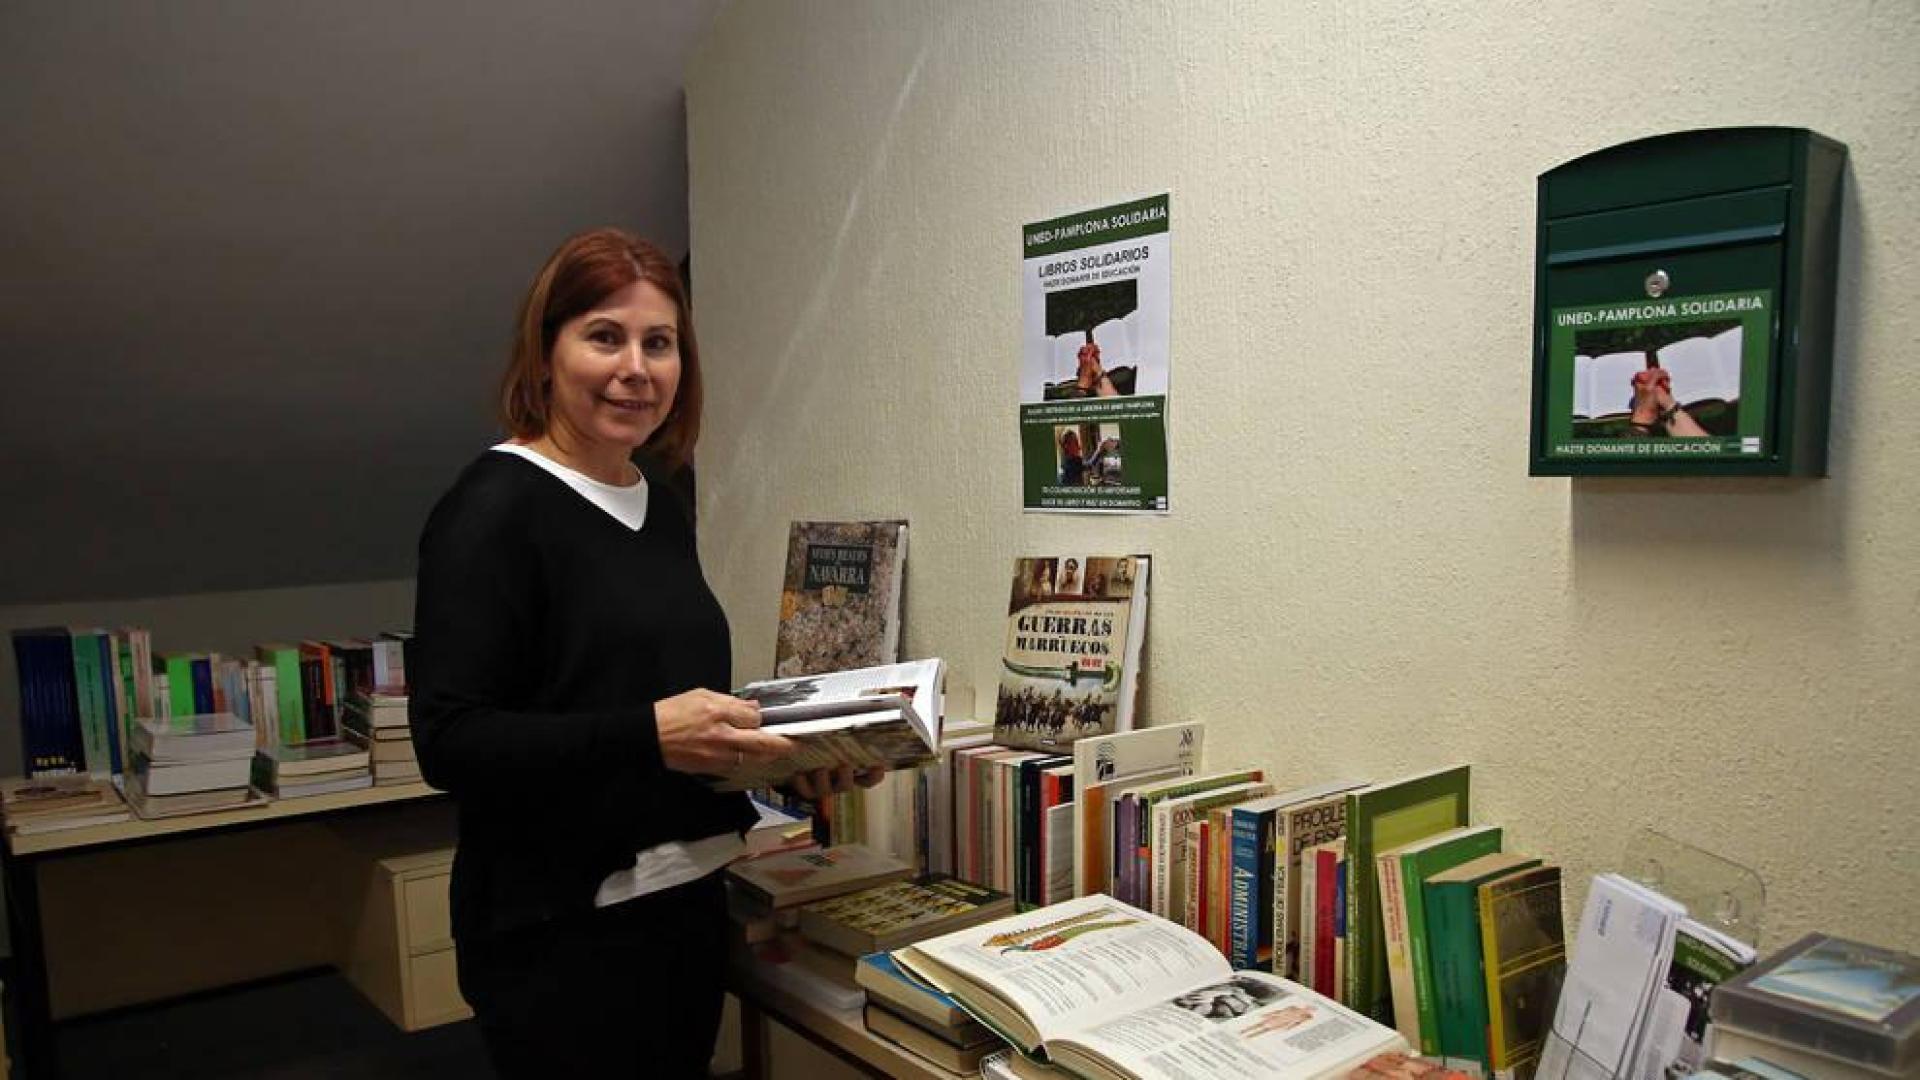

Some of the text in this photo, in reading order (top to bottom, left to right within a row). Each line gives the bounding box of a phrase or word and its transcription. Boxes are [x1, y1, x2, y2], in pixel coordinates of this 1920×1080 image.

[1026, 206, 1166, 245] UNED-PAMPLONA SOLIDARIA
[1038, 245, 1149, 278] LIBROS SOLIDARIOS
[1061, 273, 1091, 285] DONANTE
[1091, 271, 1100, 280] DE
[1101, 264, 1141, 279] EDUCACIÓN
[1557, 296, 1763, 327] UNED-PAMPLONA SOLIDARIA
[1556, 444, 1585, 455] HAZTE
[1588, 443, 1635, 454] DONANTE
[1639, 443, 1651, 453] DE
[1653, 441, 1721, 452] EDUCACIÓN
[809, 564, 864, 585] NAVARRA
[1018, 614, 1112, 637] GUERRAS
[1016, 637, 1109, 655] MARRUECOS
